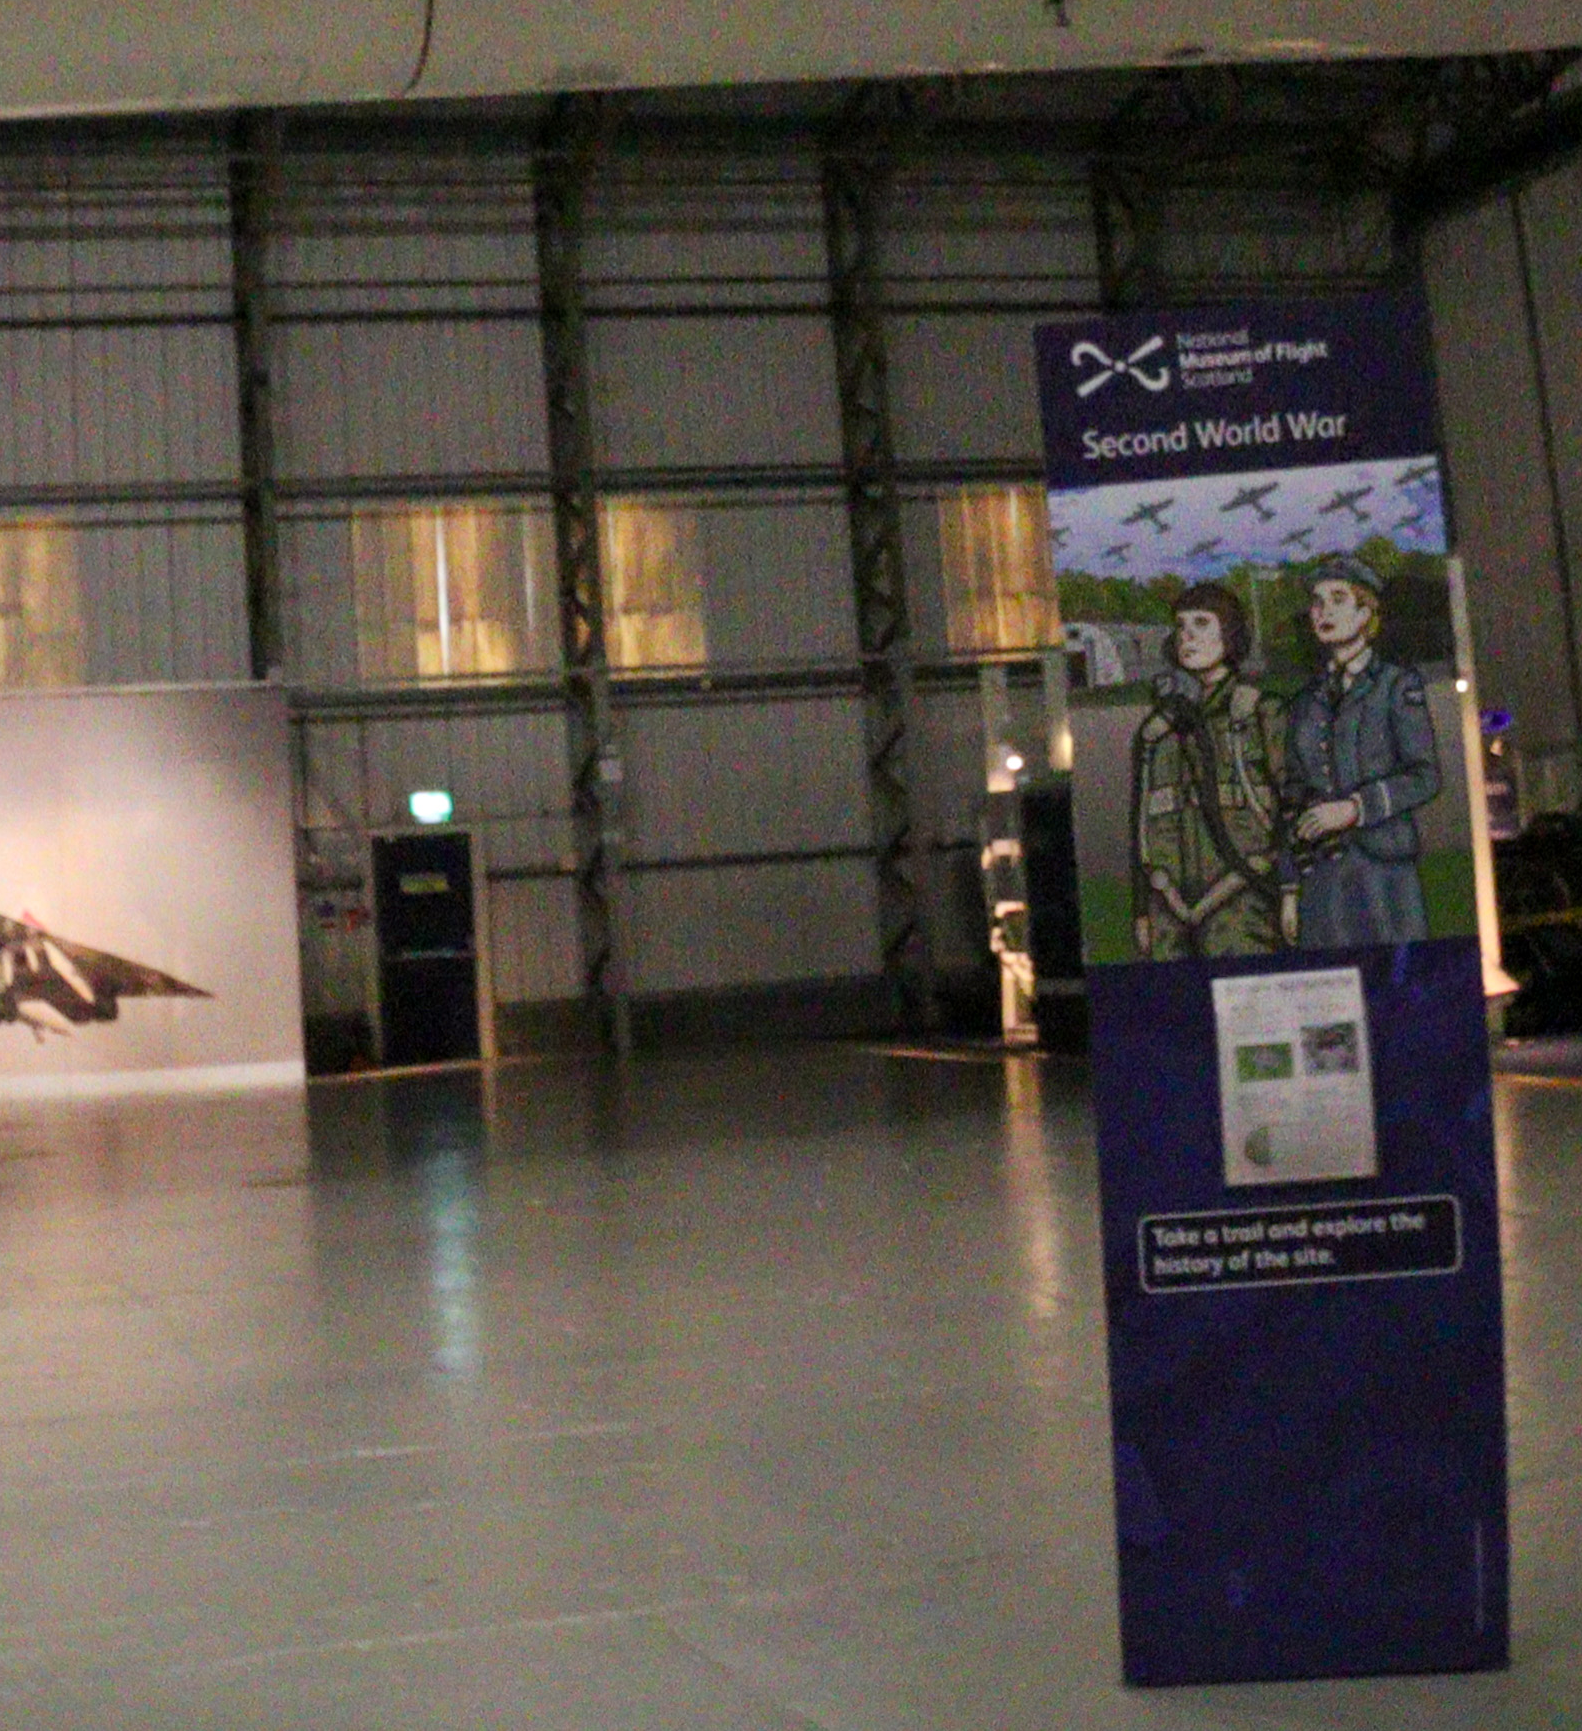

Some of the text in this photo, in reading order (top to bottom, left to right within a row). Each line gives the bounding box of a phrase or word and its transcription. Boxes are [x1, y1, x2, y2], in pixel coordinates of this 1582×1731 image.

[1175, 329, 1250, 350] National
[1179, 341, 1329, 370] Museum of Flight
[1180, 368, 1254, 390] Scotland
[1081, 411, 1347, 460] Second World War
[1151, 1211, 1426, 1248] Take a trail and explore the
[1153, 1247, 1335, 1279] history of the site.
